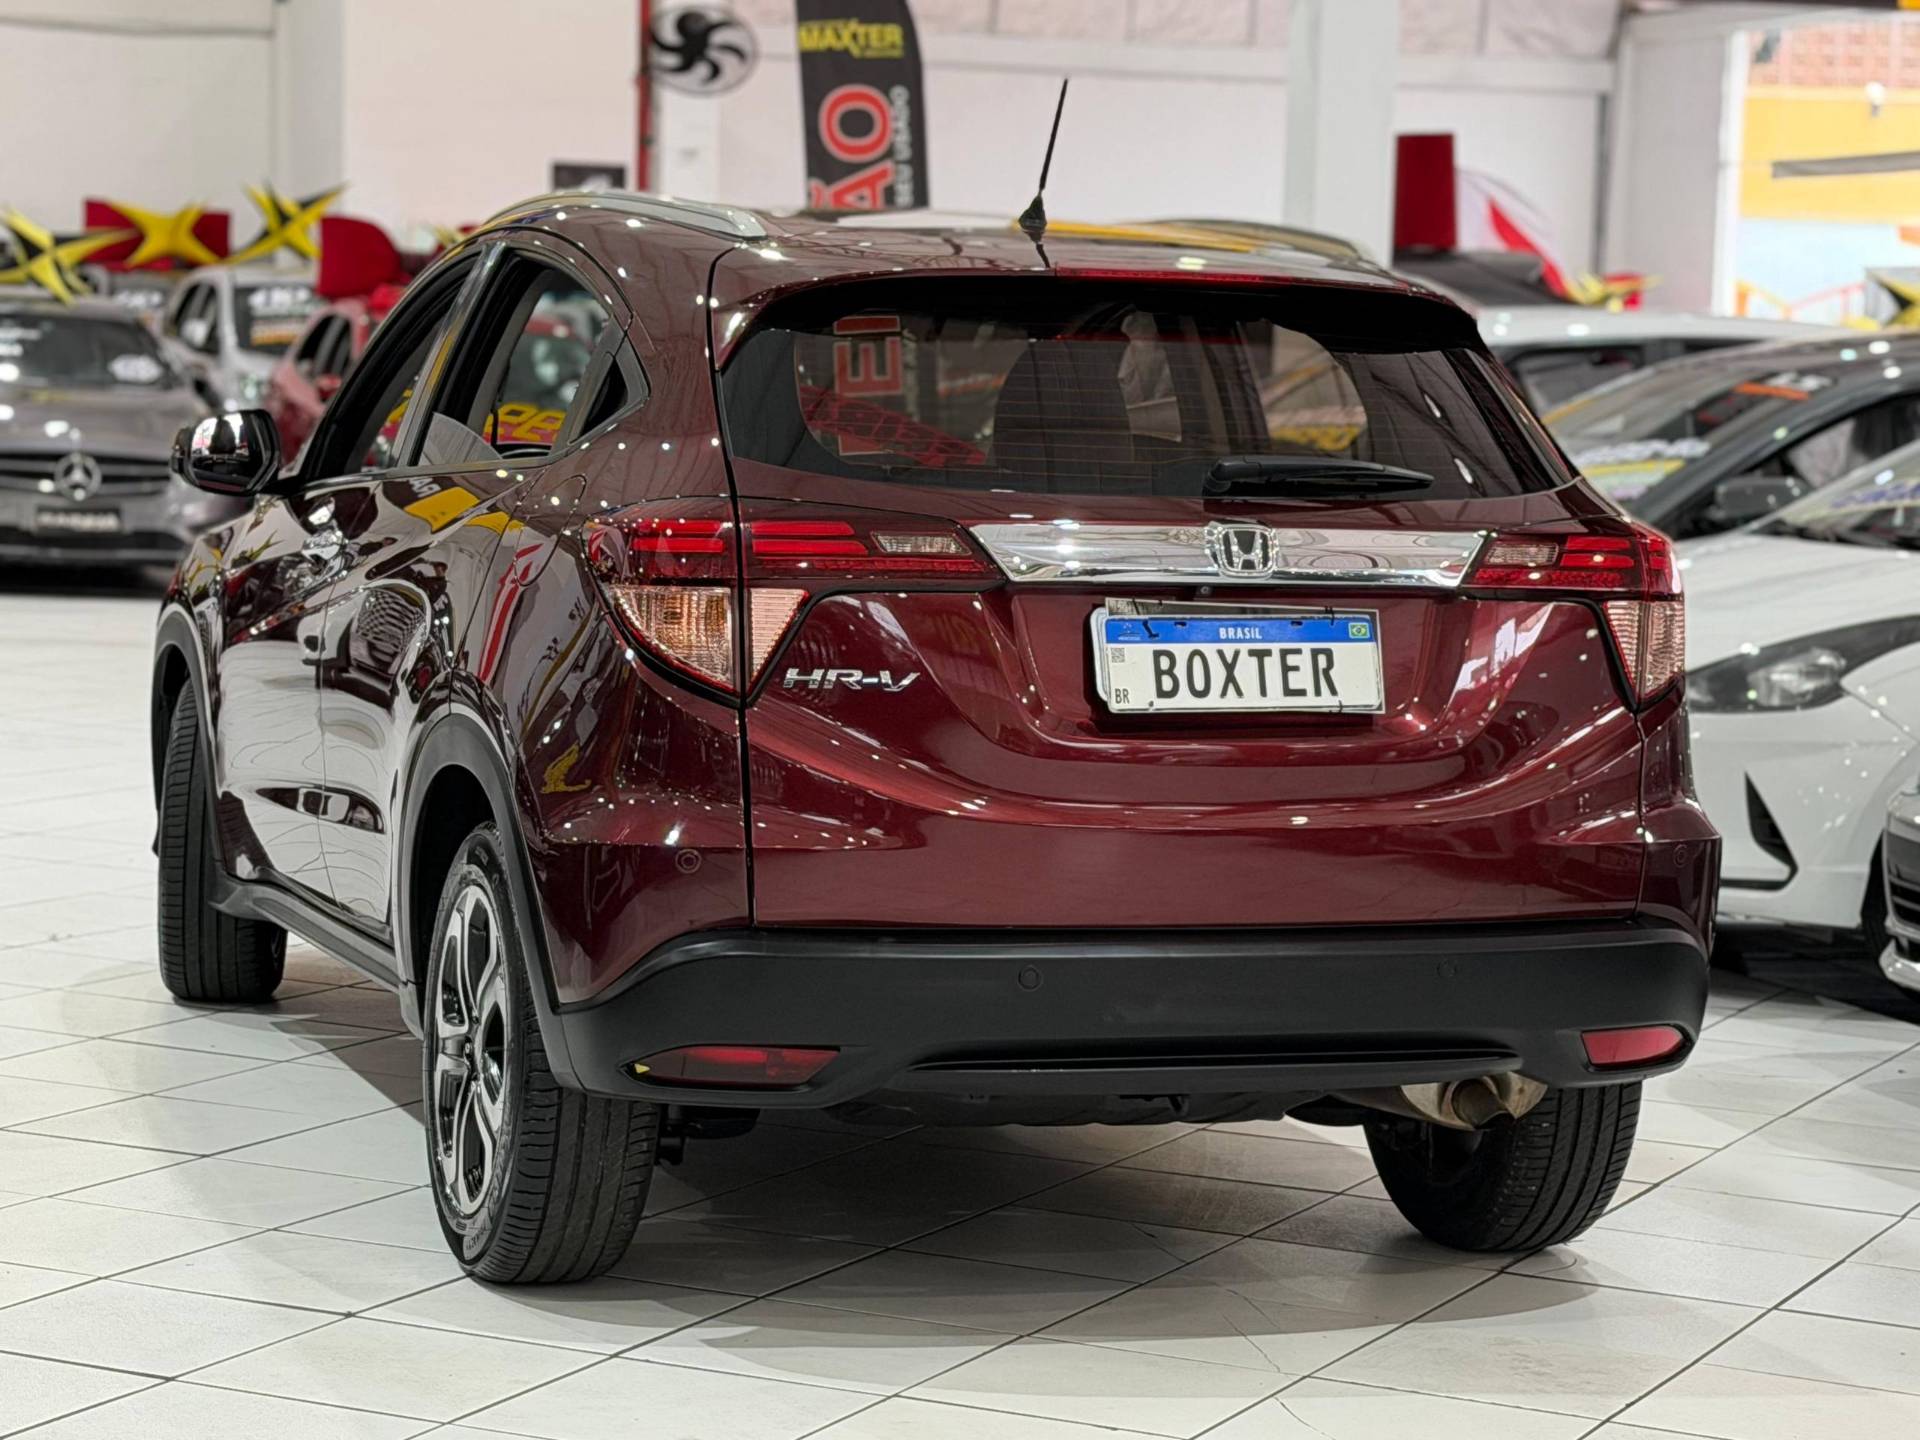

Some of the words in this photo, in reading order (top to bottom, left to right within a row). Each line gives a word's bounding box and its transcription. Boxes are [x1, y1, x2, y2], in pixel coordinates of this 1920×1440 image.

[798, 20, 904, 54] MAXTER
[1218, 626, 1263, 640] BRASIL
[783, 668, 921, 693] HR-V
[1152, 647, 1338, 699] BOXTER
[1114, 688, 1130, 705] BR
